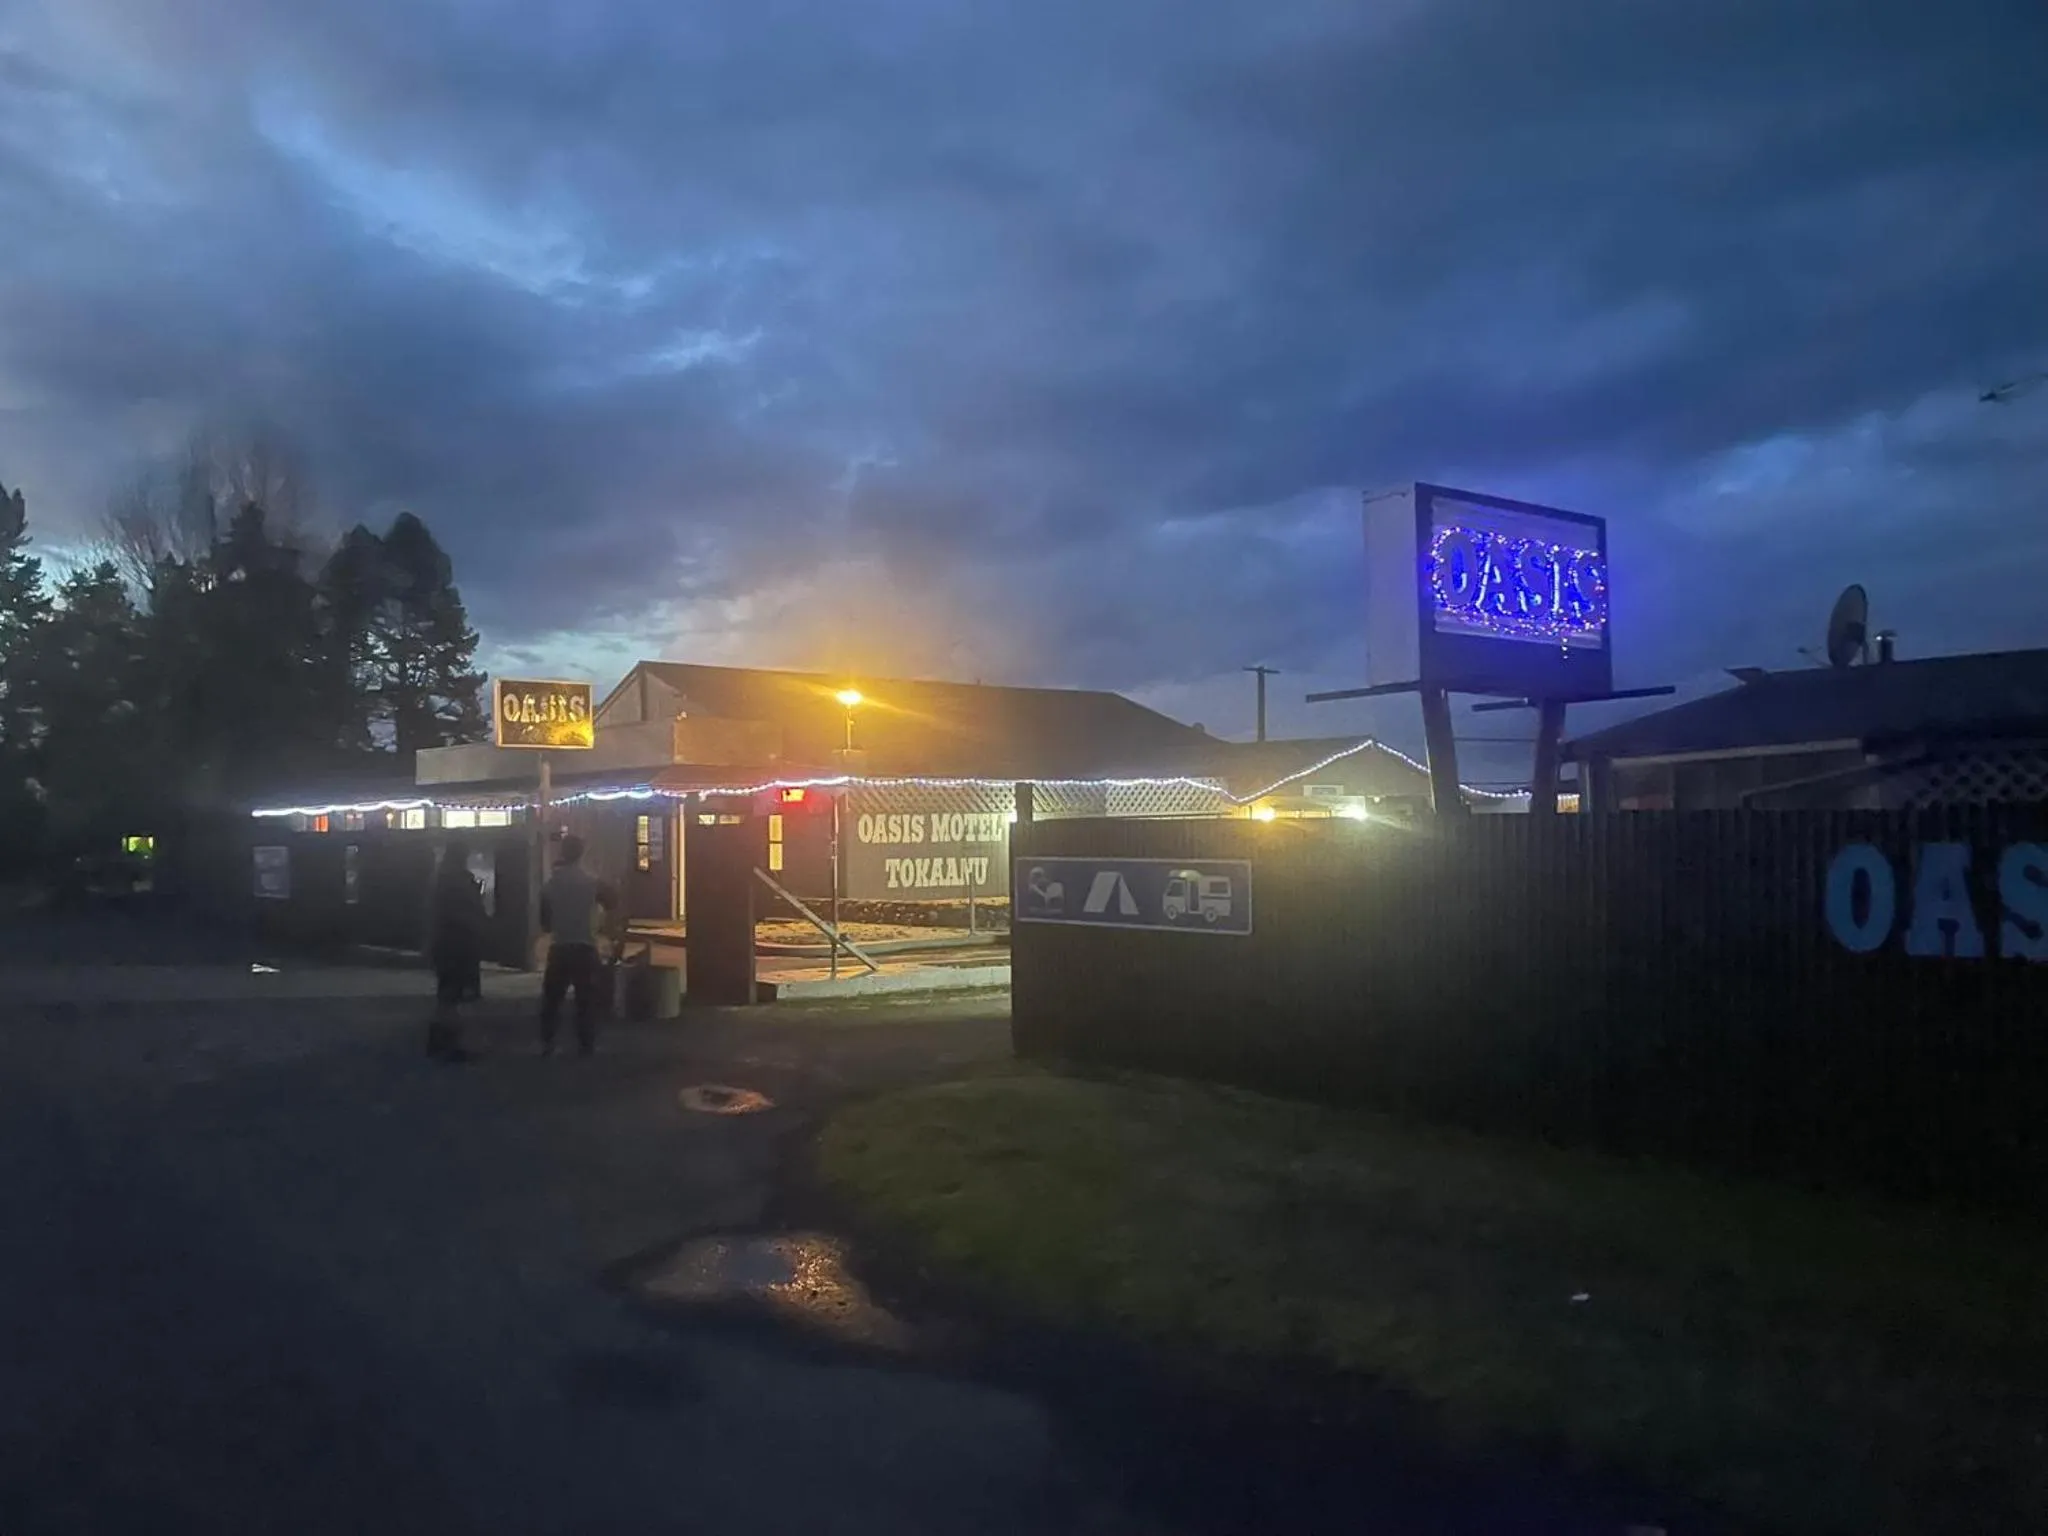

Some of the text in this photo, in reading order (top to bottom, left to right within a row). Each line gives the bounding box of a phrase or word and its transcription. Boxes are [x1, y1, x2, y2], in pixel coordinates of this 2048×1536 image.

[1431, 527, 1608, 632] OASIS
[858, 813, 1003, 844] OASIS MOTEL
[885, 857, 990, 888] TOKAANU
